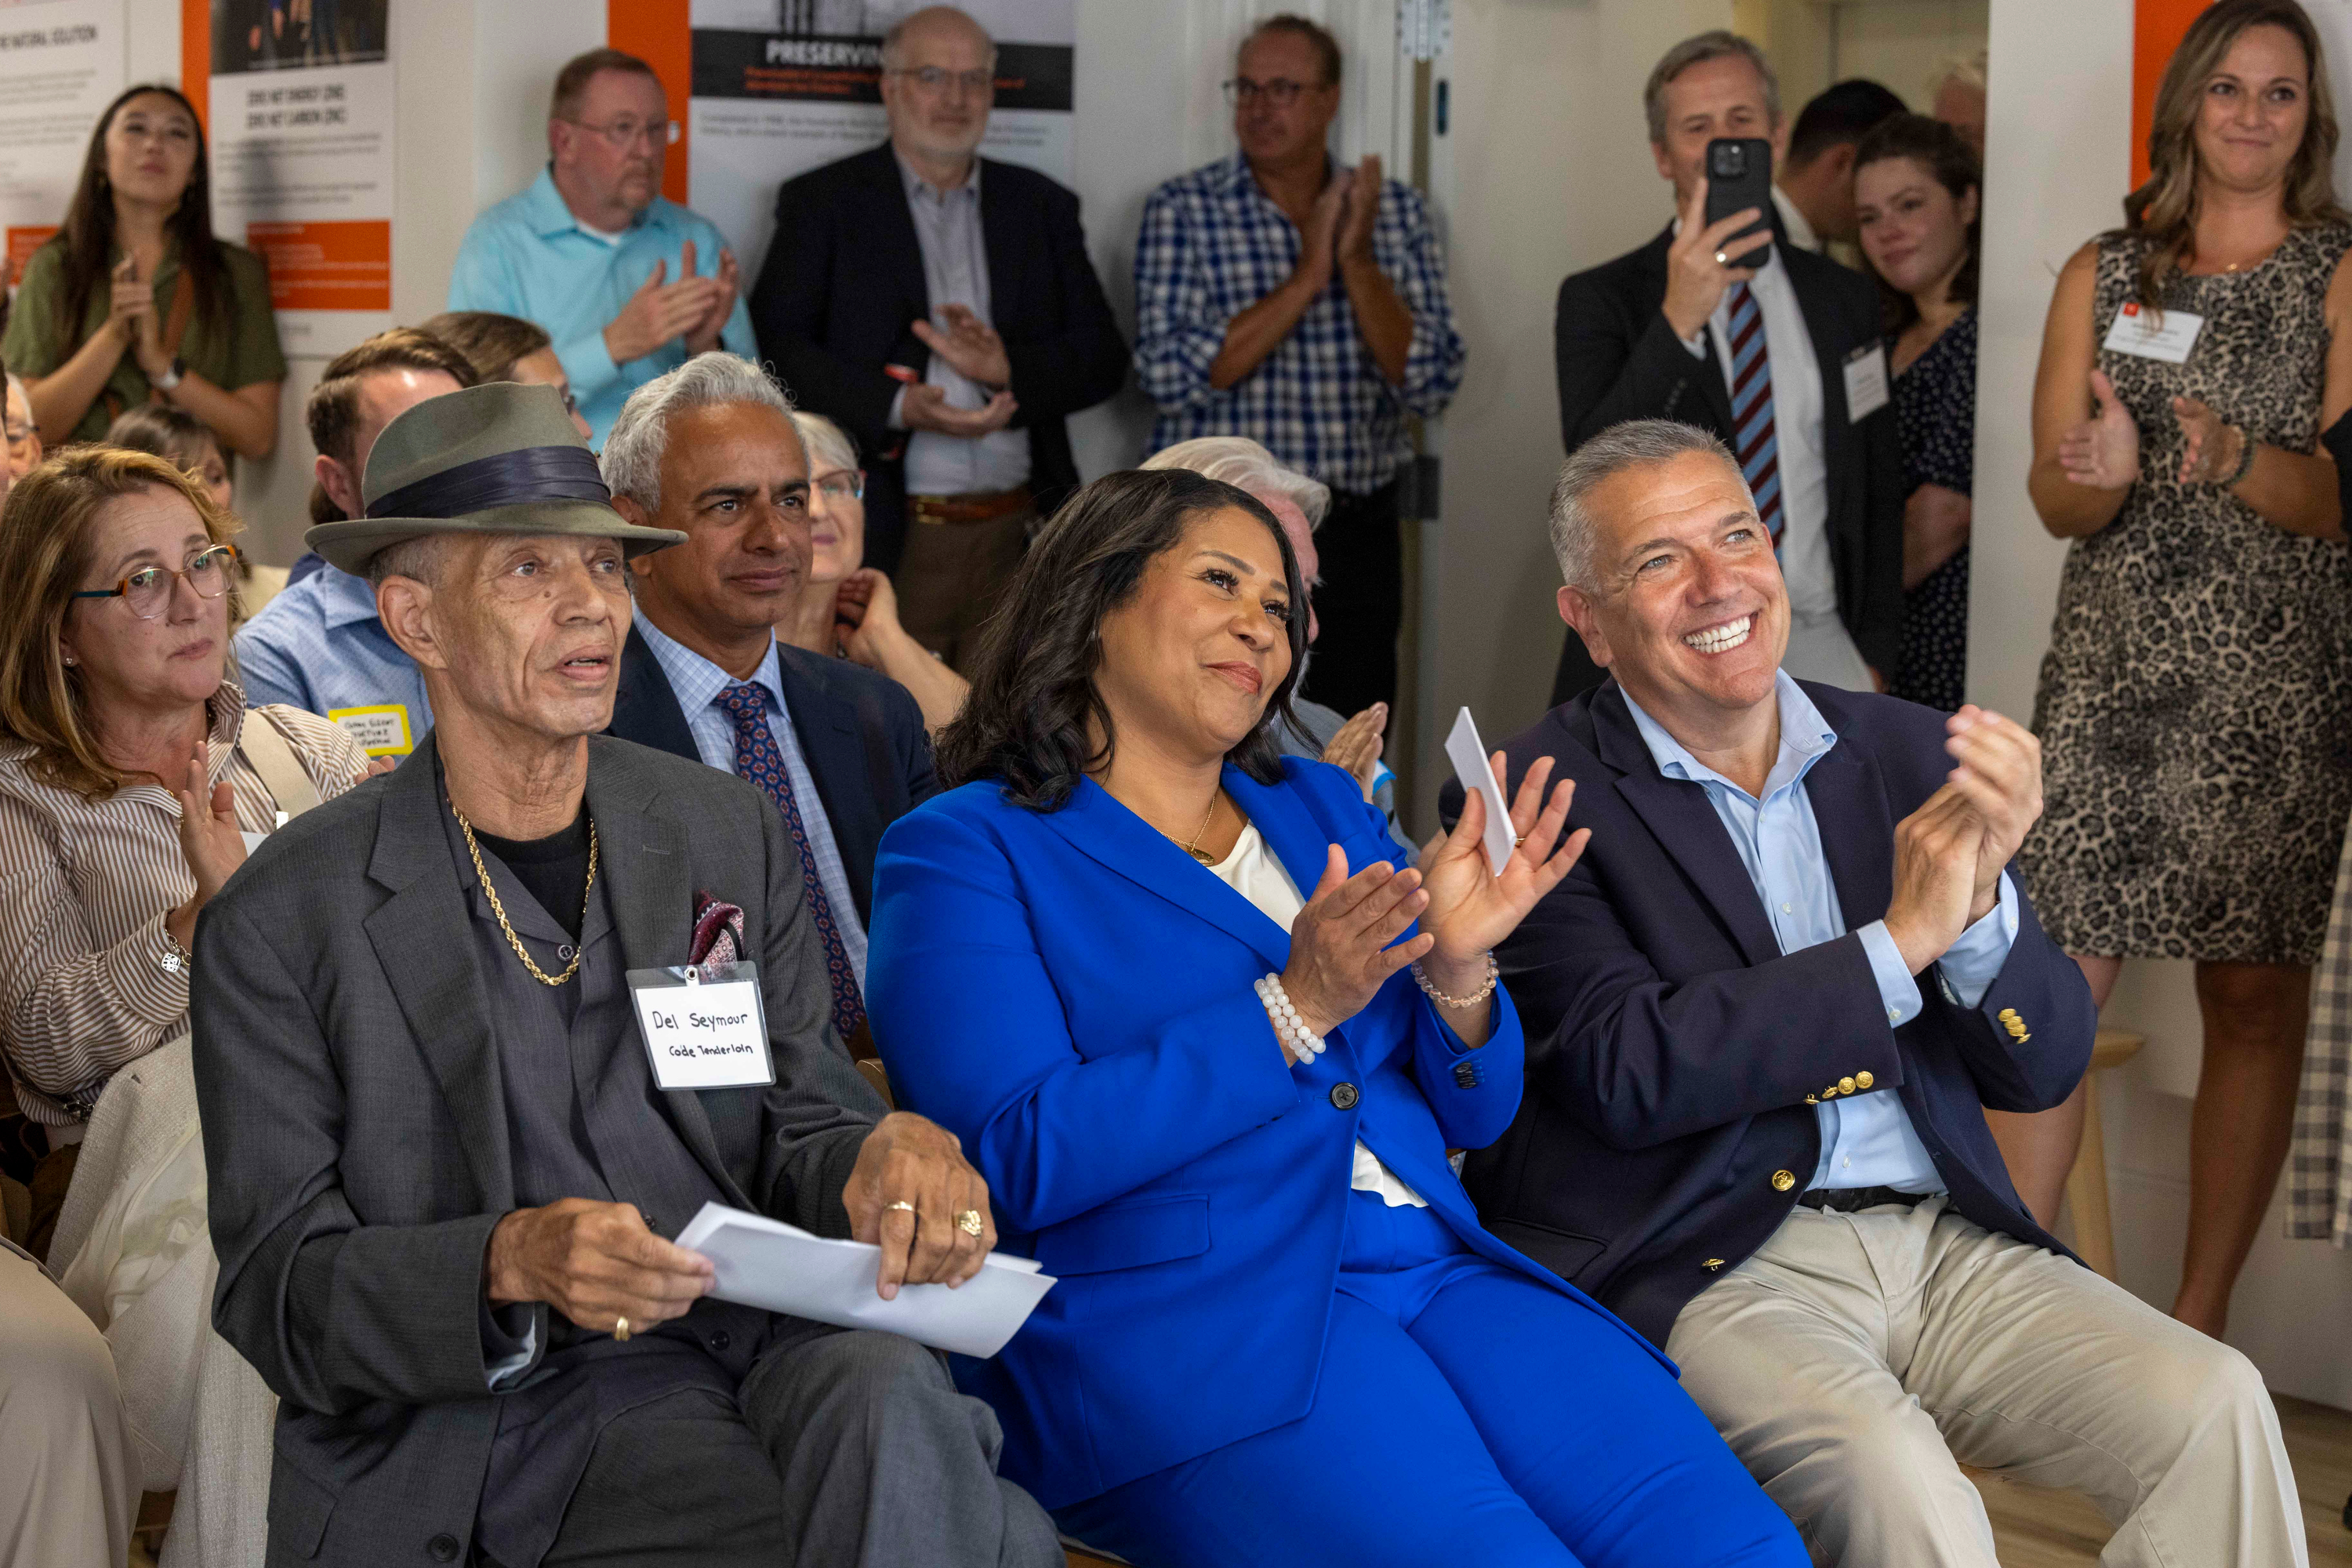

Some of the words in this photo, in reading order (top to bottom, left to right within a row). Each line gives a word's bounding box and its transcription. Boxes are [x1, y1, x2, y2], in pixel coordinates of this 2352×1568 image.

[50, 24, 97, 45] SOLUTION
[765, 38, 883, 67] PRESERVIN
[652, 1011, 679, 1029] Del
[689, 1012, 748, 1033] Seymour
[669, 1044, 696, 1058] Code
[697, 1044, 753, 1056] Tenderloin
